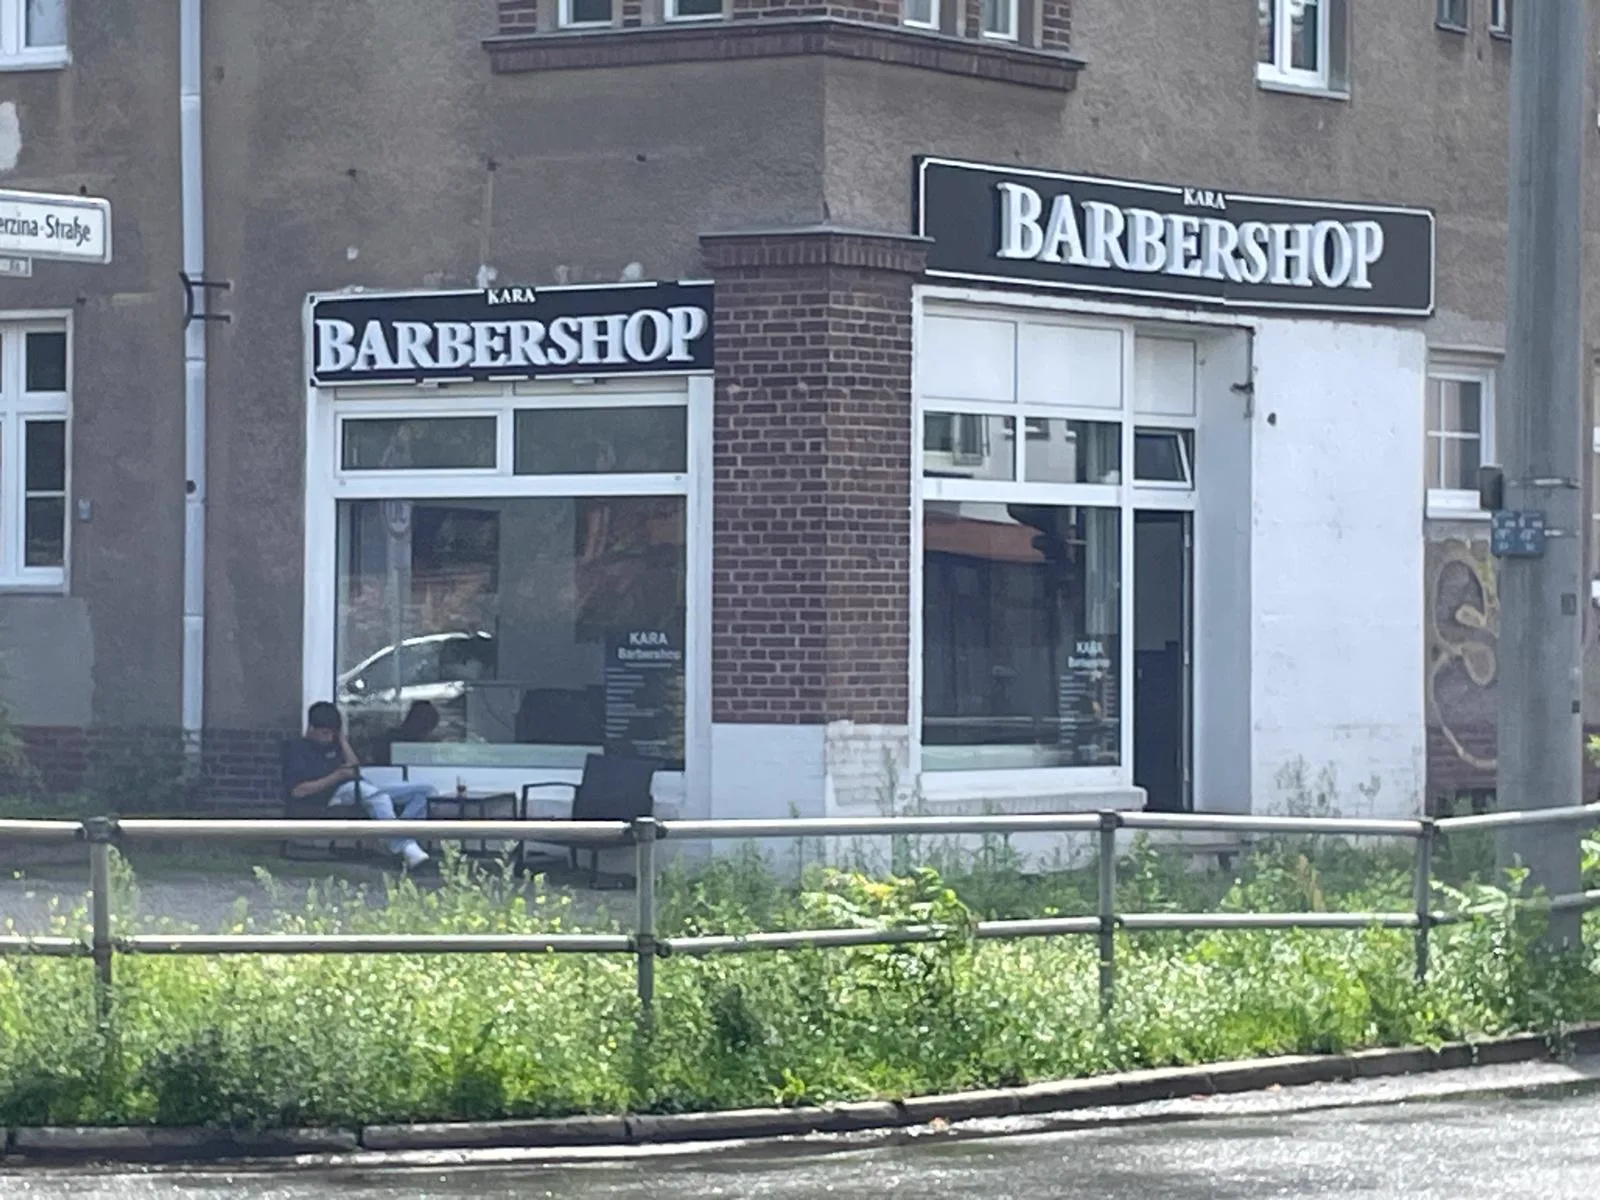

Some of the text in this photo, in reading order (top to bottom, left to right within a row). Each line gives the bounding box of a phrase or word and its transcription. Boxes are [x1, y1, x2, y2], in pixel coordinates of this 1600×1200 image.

[1183, 187, 1226, 210] KARA
[997, 182, 1385, 290] BARBERSHOP
[488, 288, 536, 304] KARA
[315, 306, 709, 372] BARBERSHOP
[629, 631, 669, 646] KARA
